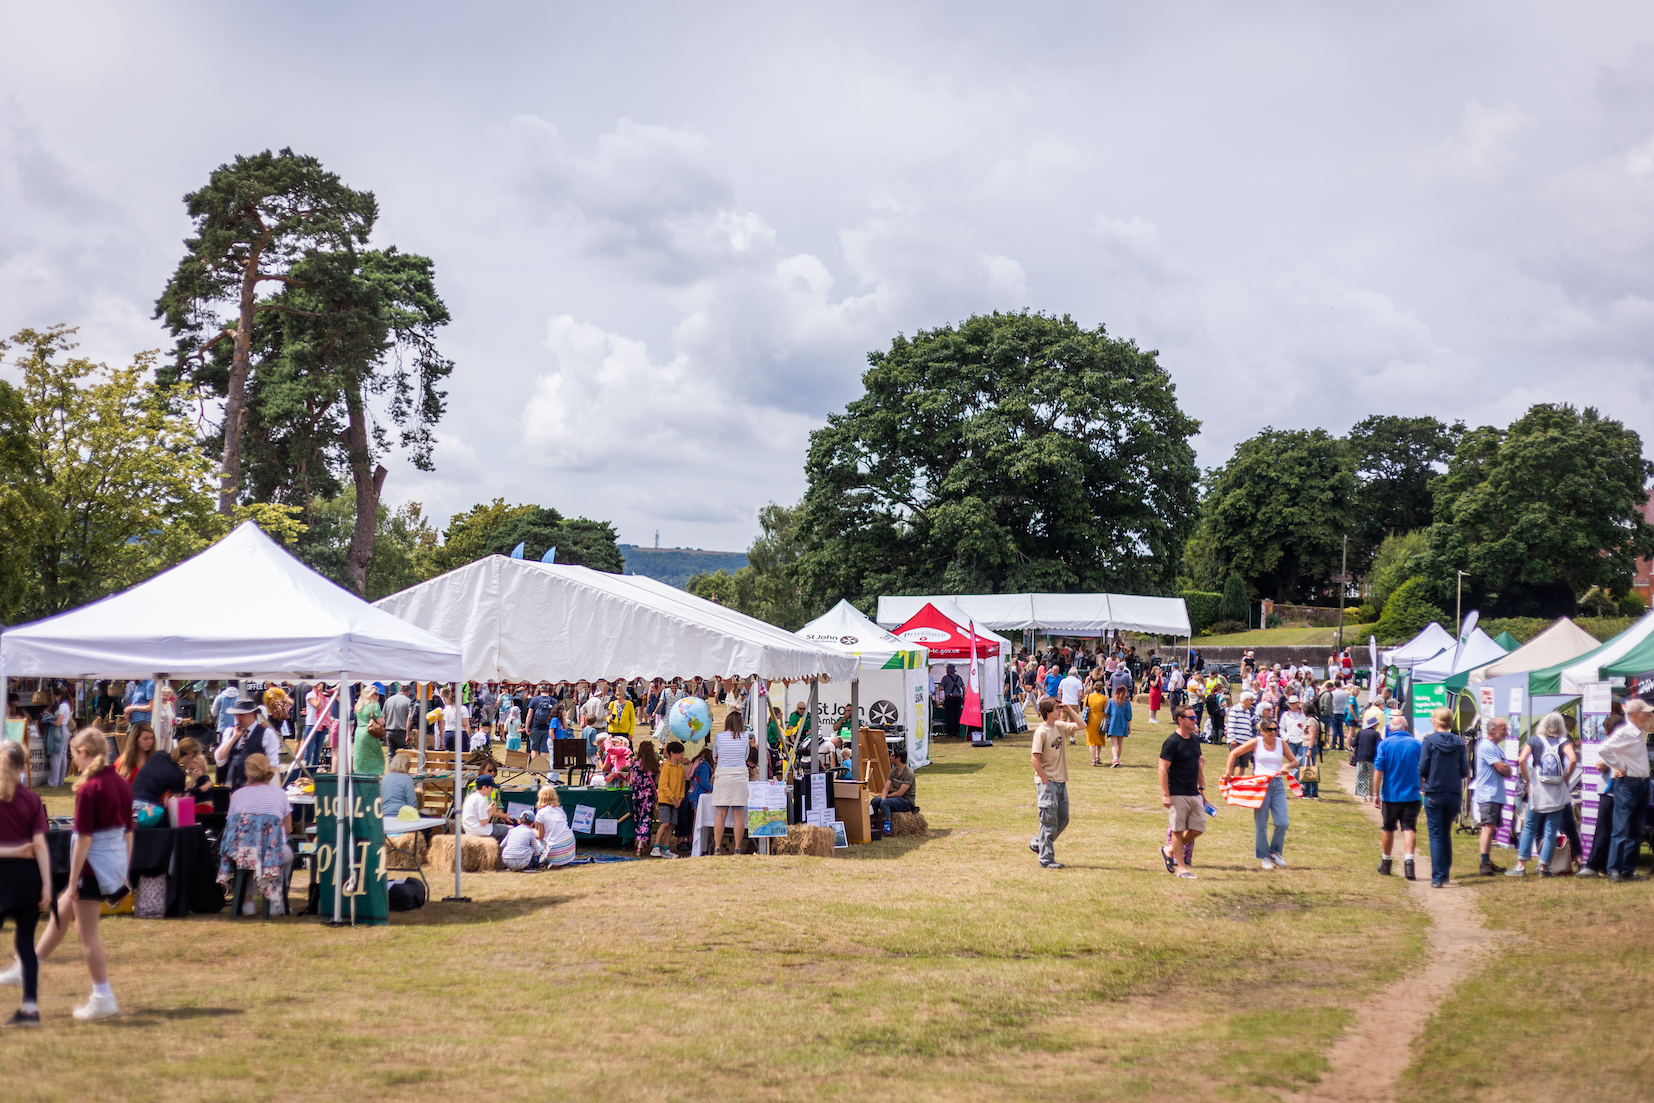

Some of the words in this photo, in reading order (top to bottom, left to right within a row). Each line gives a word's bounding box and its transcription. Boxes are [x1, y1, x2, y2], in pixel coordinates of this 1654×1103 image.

[817, 702, 829, 716] St
[832, 702, 865, 716] Jon
[30, 749, 43, 759] OFFEE
